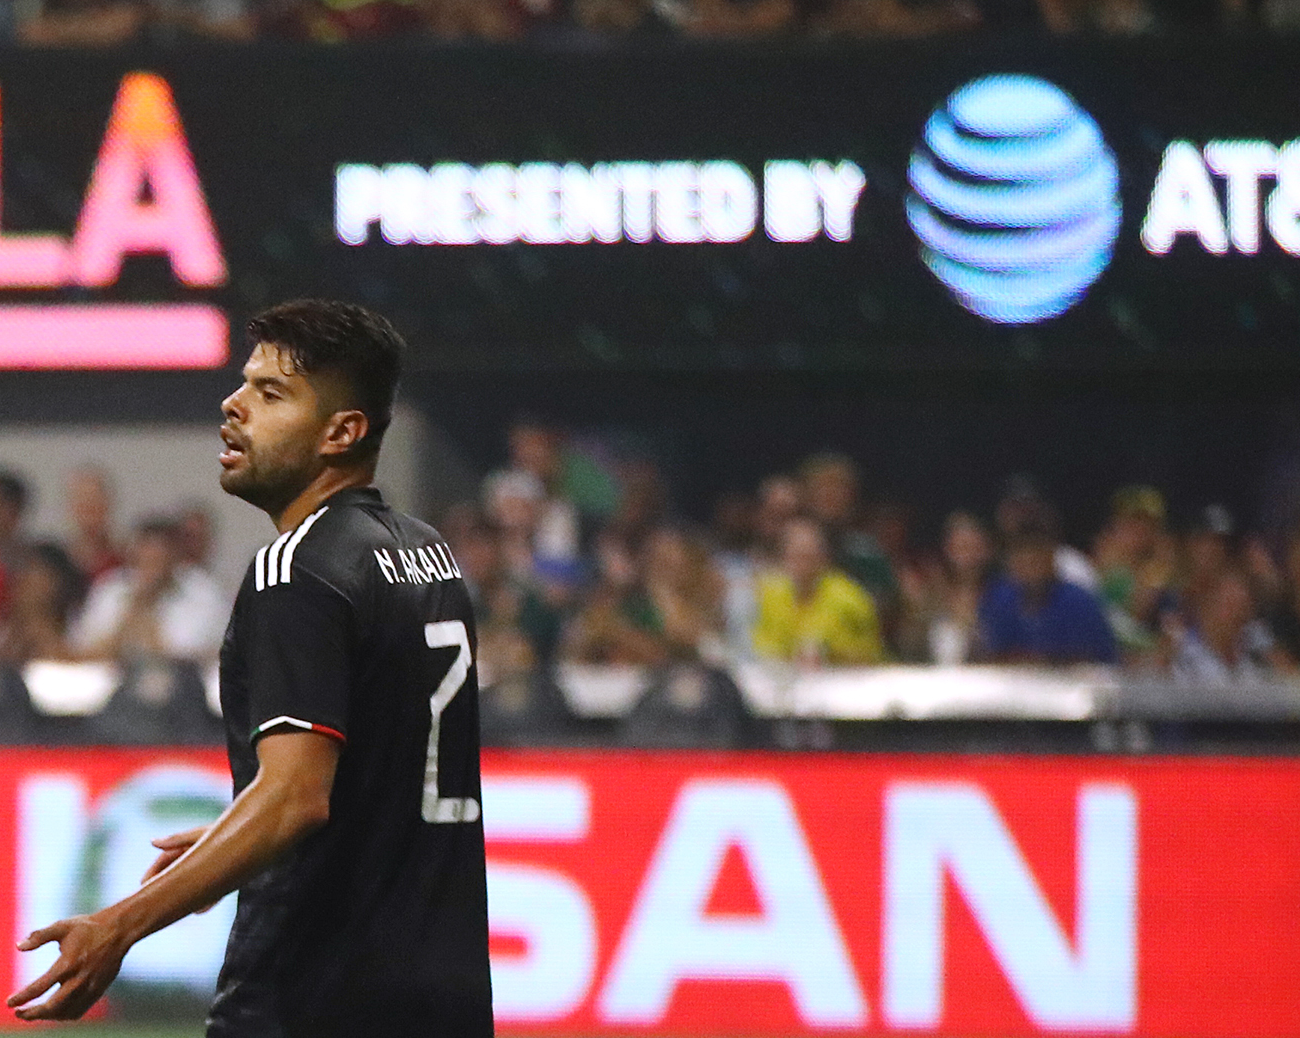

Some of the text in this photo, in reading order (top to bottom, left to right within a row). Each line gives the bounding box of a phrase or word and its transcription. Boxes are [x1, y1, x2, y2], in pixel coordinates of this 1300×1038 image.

[335, 160, 866, 245] PRESENTED BY
[373, 547, 405, 585] N.
[421, 619, 481, 824] 2
